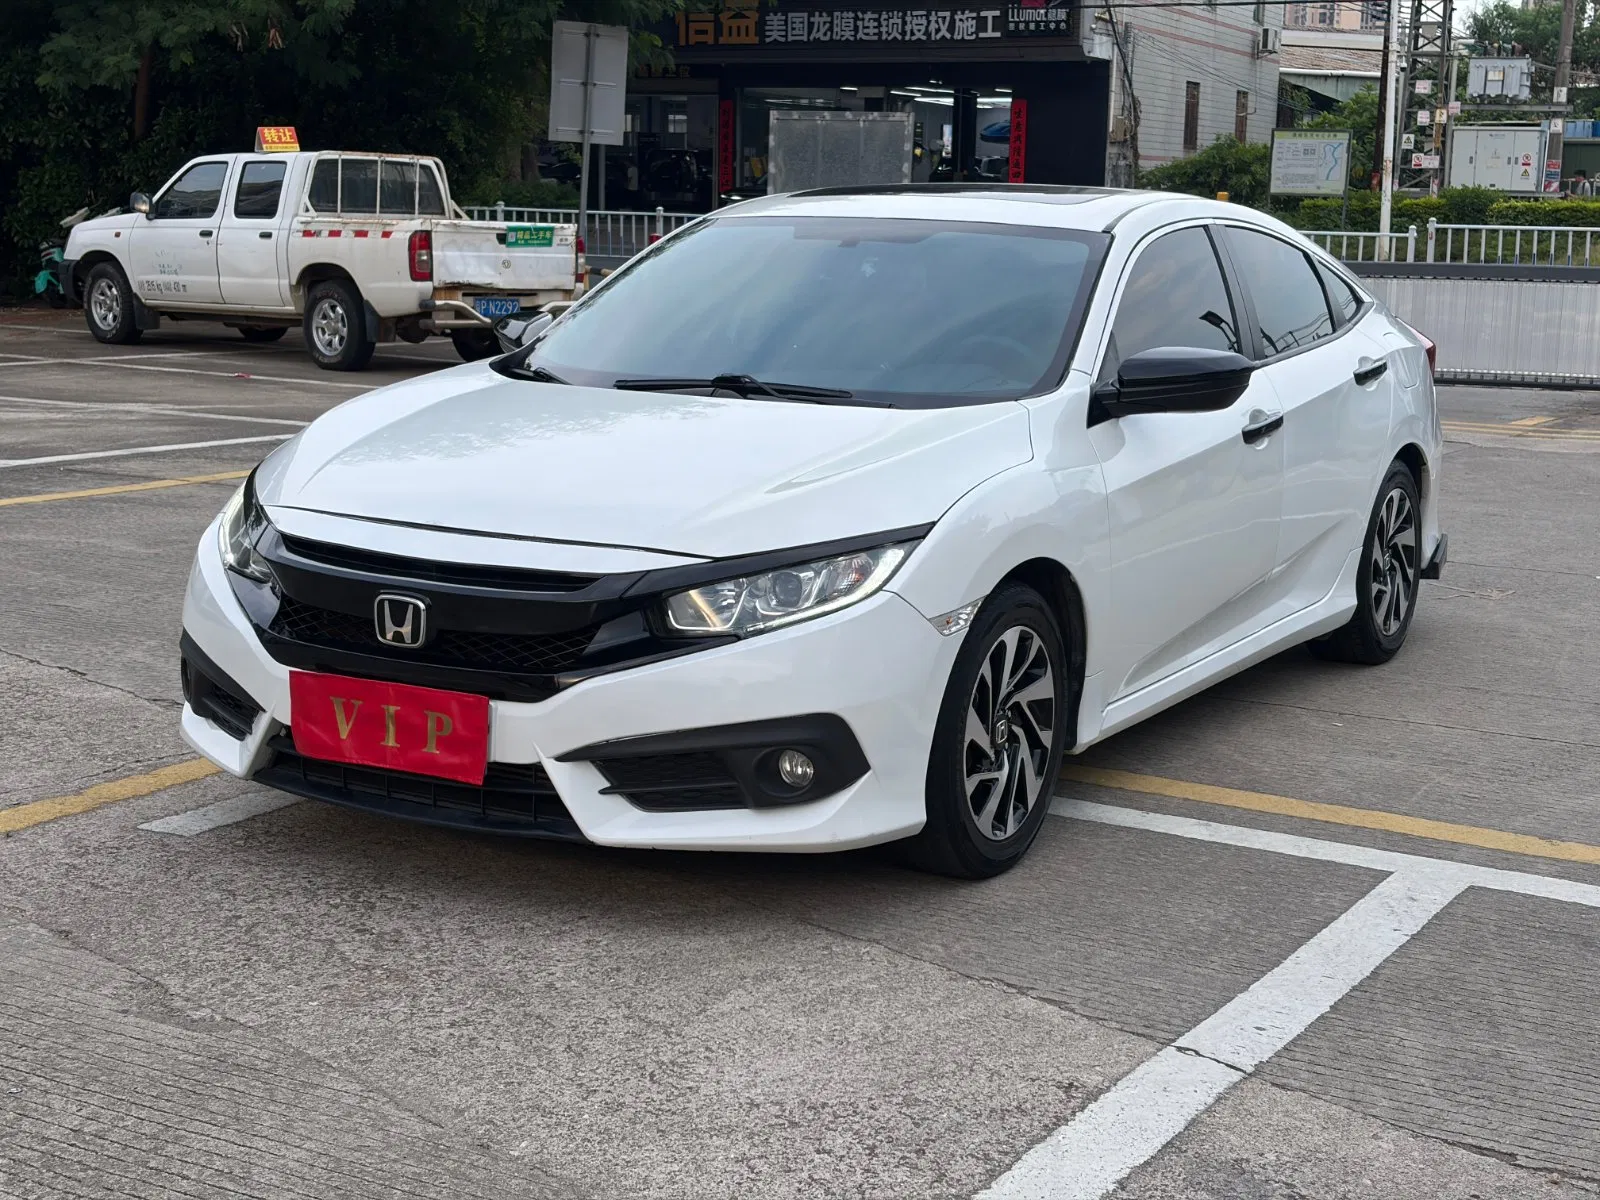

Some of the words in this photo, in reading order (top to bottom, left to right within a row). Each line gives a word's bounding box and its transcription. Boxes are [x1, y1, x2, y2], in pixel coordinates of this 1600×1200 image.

[764, 9, 1002, 44] 美国龙膜连锁授权施工
[263, 128, 295, 143] 转让
[329, 696, 453, 754] VIP
